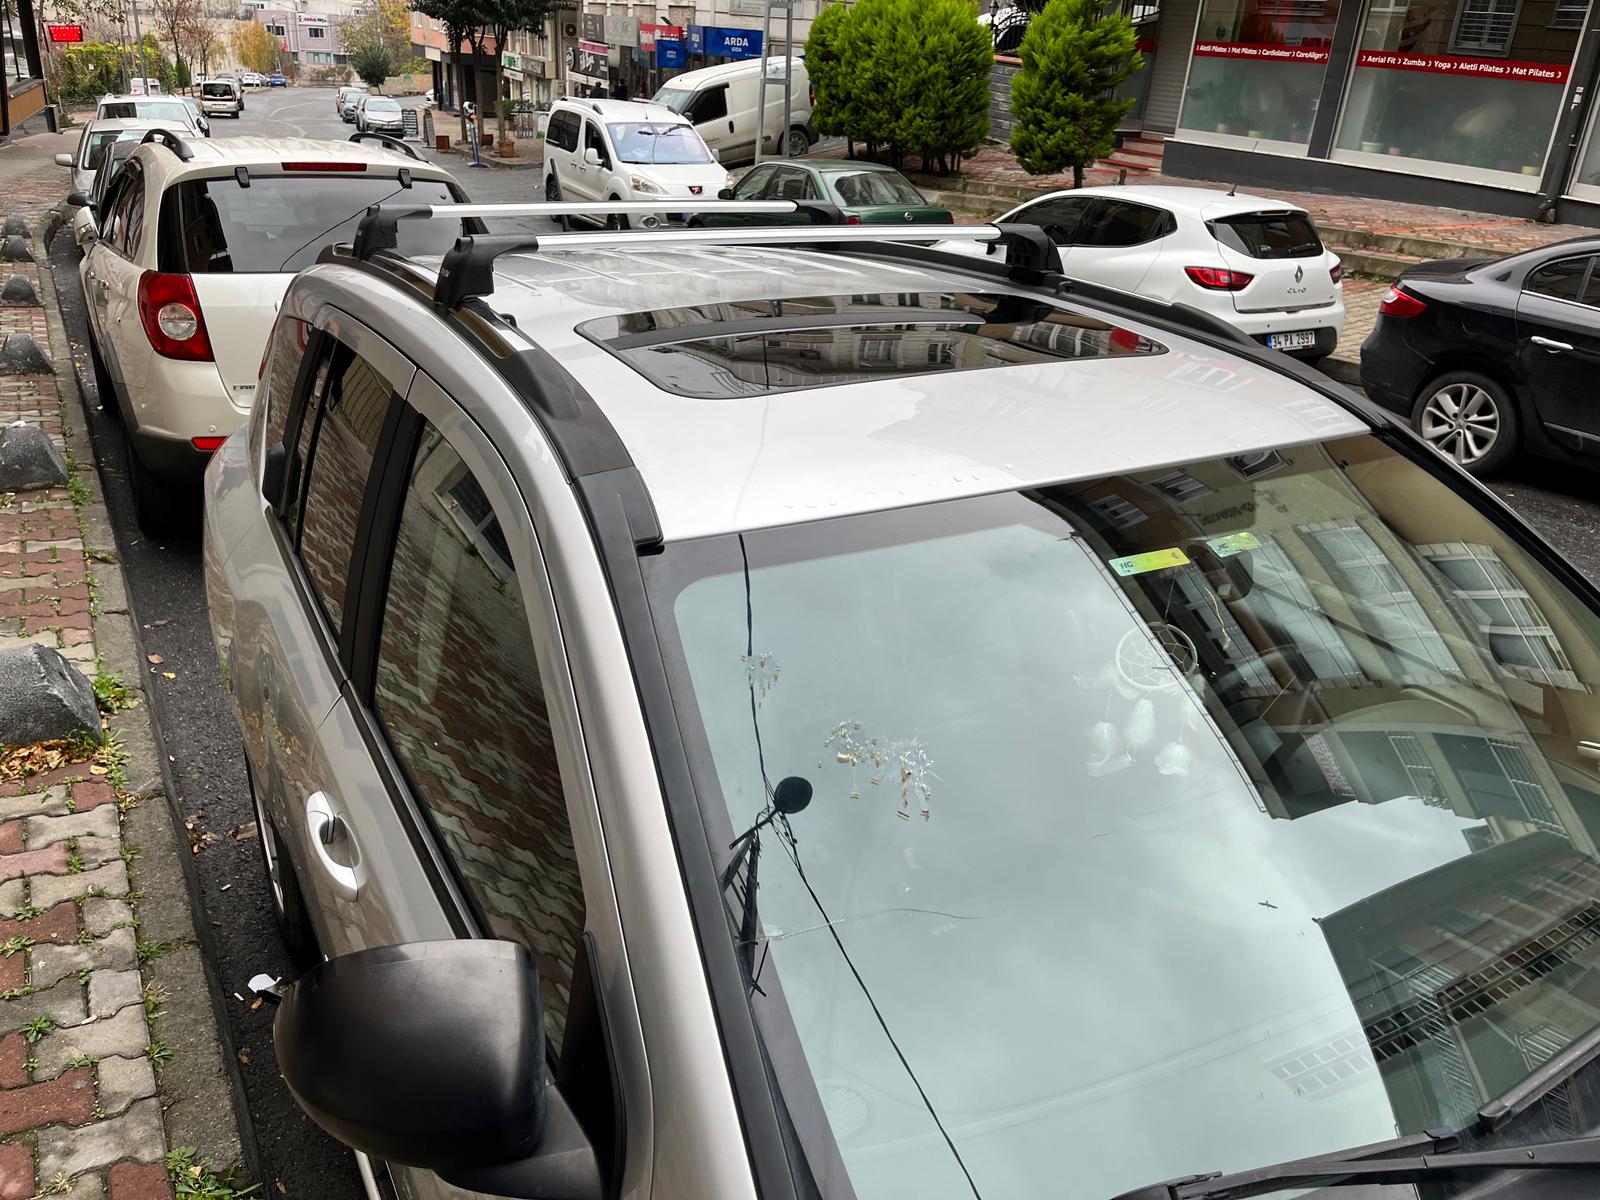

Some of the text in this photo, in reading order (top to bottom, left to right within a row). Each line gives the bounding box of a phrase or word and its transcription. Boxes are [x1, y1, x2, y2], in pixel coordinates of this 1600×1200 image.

[724, 36, 749, 47] ARDA
[1211, 45, 1227, 53] Pilates
[1231, 46, 1240, 54] Mat
[1241, 47, 1257, 55] Pilates
[1367, 55, 1555, 78] Aerial Fit Zumba Yoga Aletli Pilates Mat Pilates
[1272, 332, 1314, 347] 34 PA 2997
